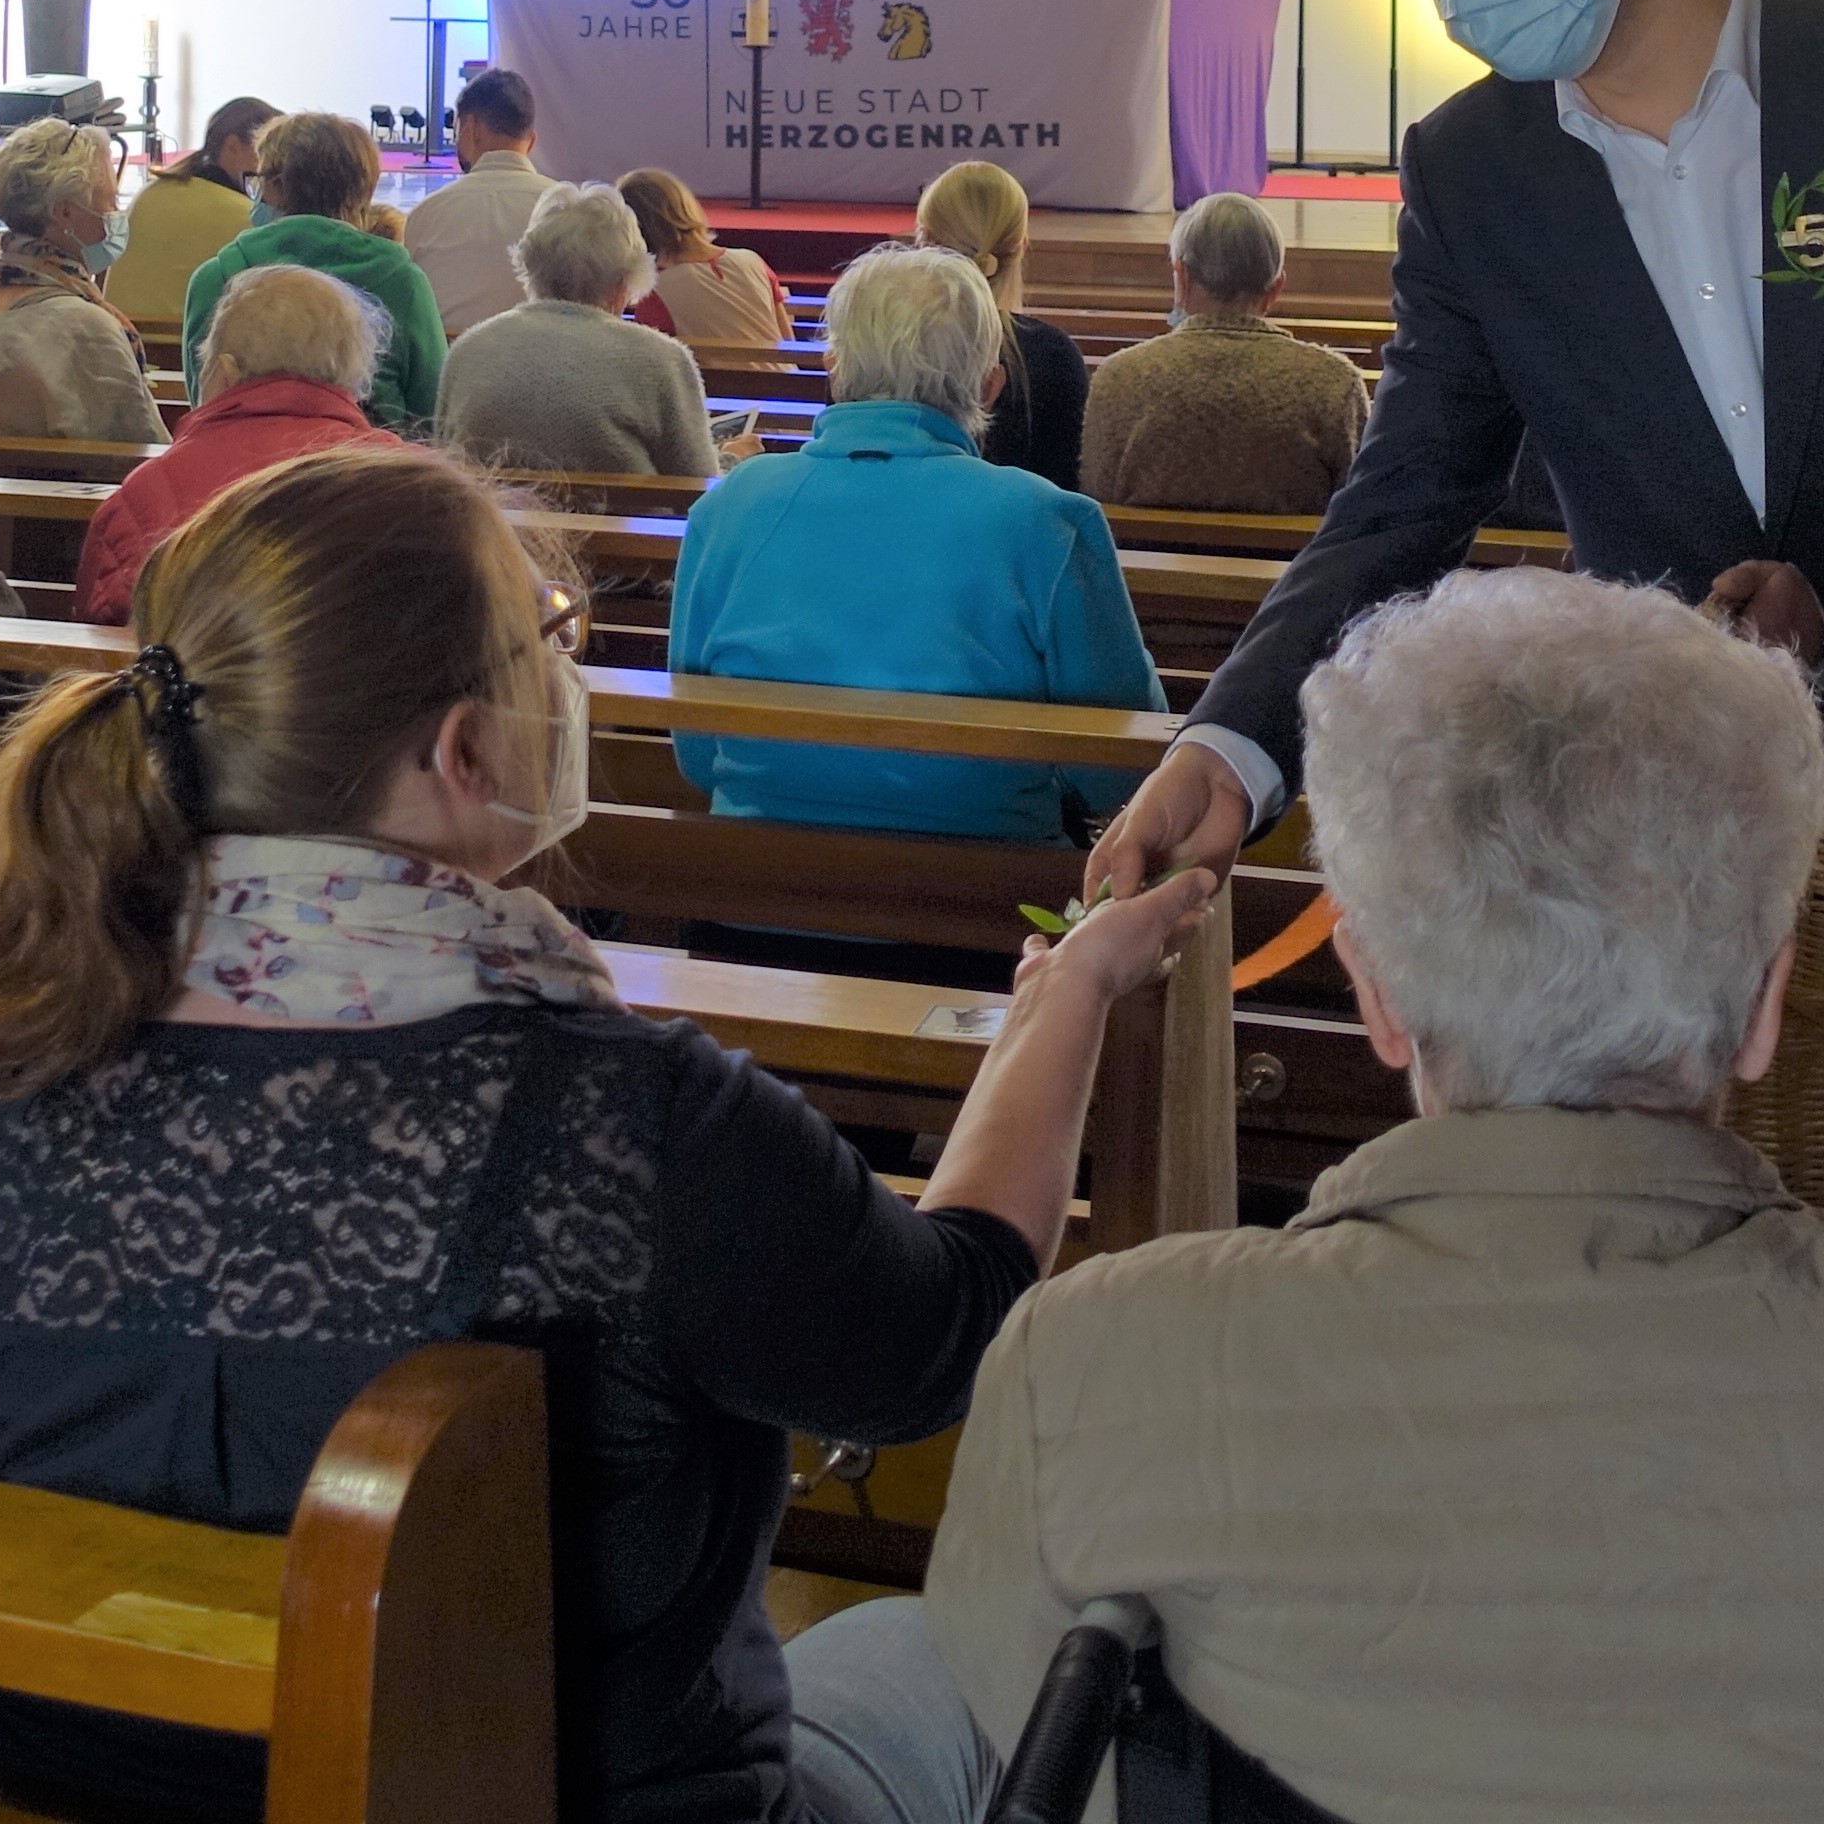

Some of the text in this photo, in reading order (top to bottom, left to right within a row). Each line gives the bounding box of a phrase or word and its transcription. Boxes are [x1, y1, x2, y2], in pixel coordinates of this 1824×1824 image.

[579, 15, 692, 39] JAHRE
[725, 87, 990, 115] NEUE STADT
[725, 121, 1061, 150] HERZOGENRATH
